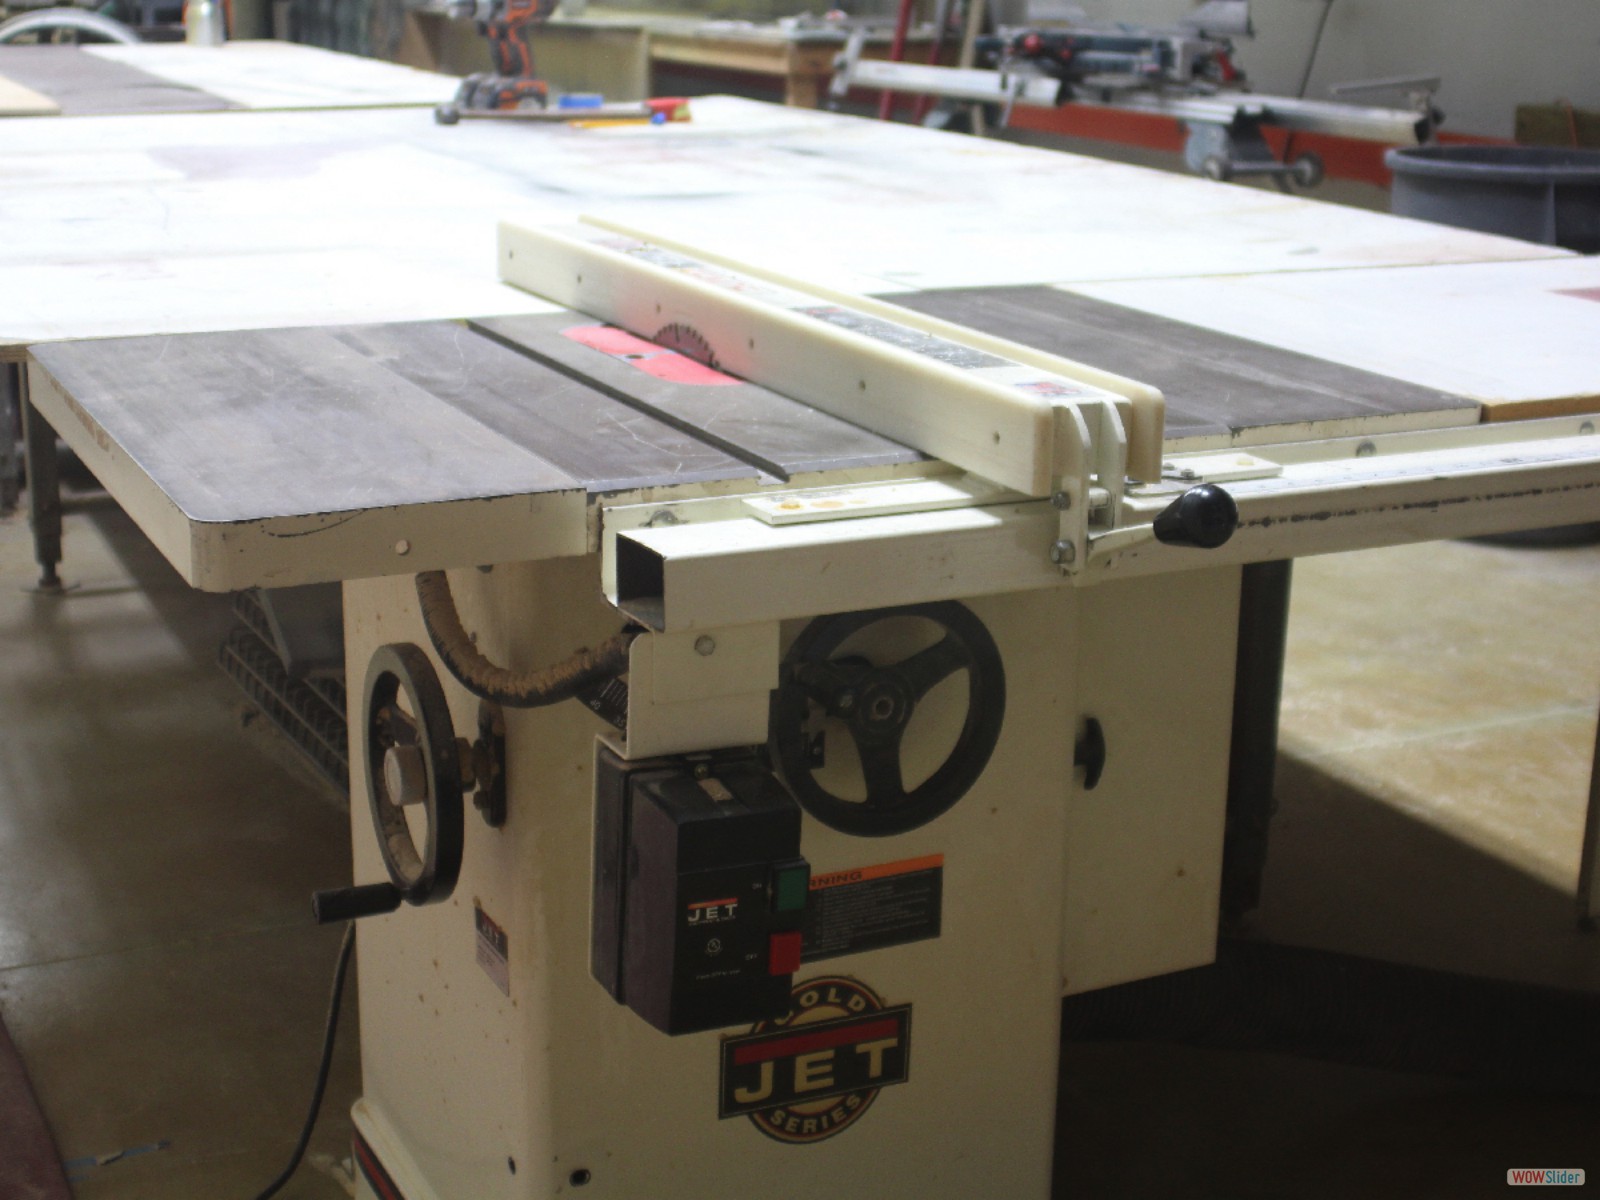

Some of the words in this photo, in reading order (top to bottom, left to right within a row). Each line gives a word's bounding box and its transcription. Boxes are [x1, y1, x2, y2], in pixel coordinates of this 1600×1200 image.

[809, 871, 862, 887] RNING
[687, 903, 738, 922] JET
[734, 1037, 899, 1104] JET
[768, 1093, 861, 1134] SERIES
